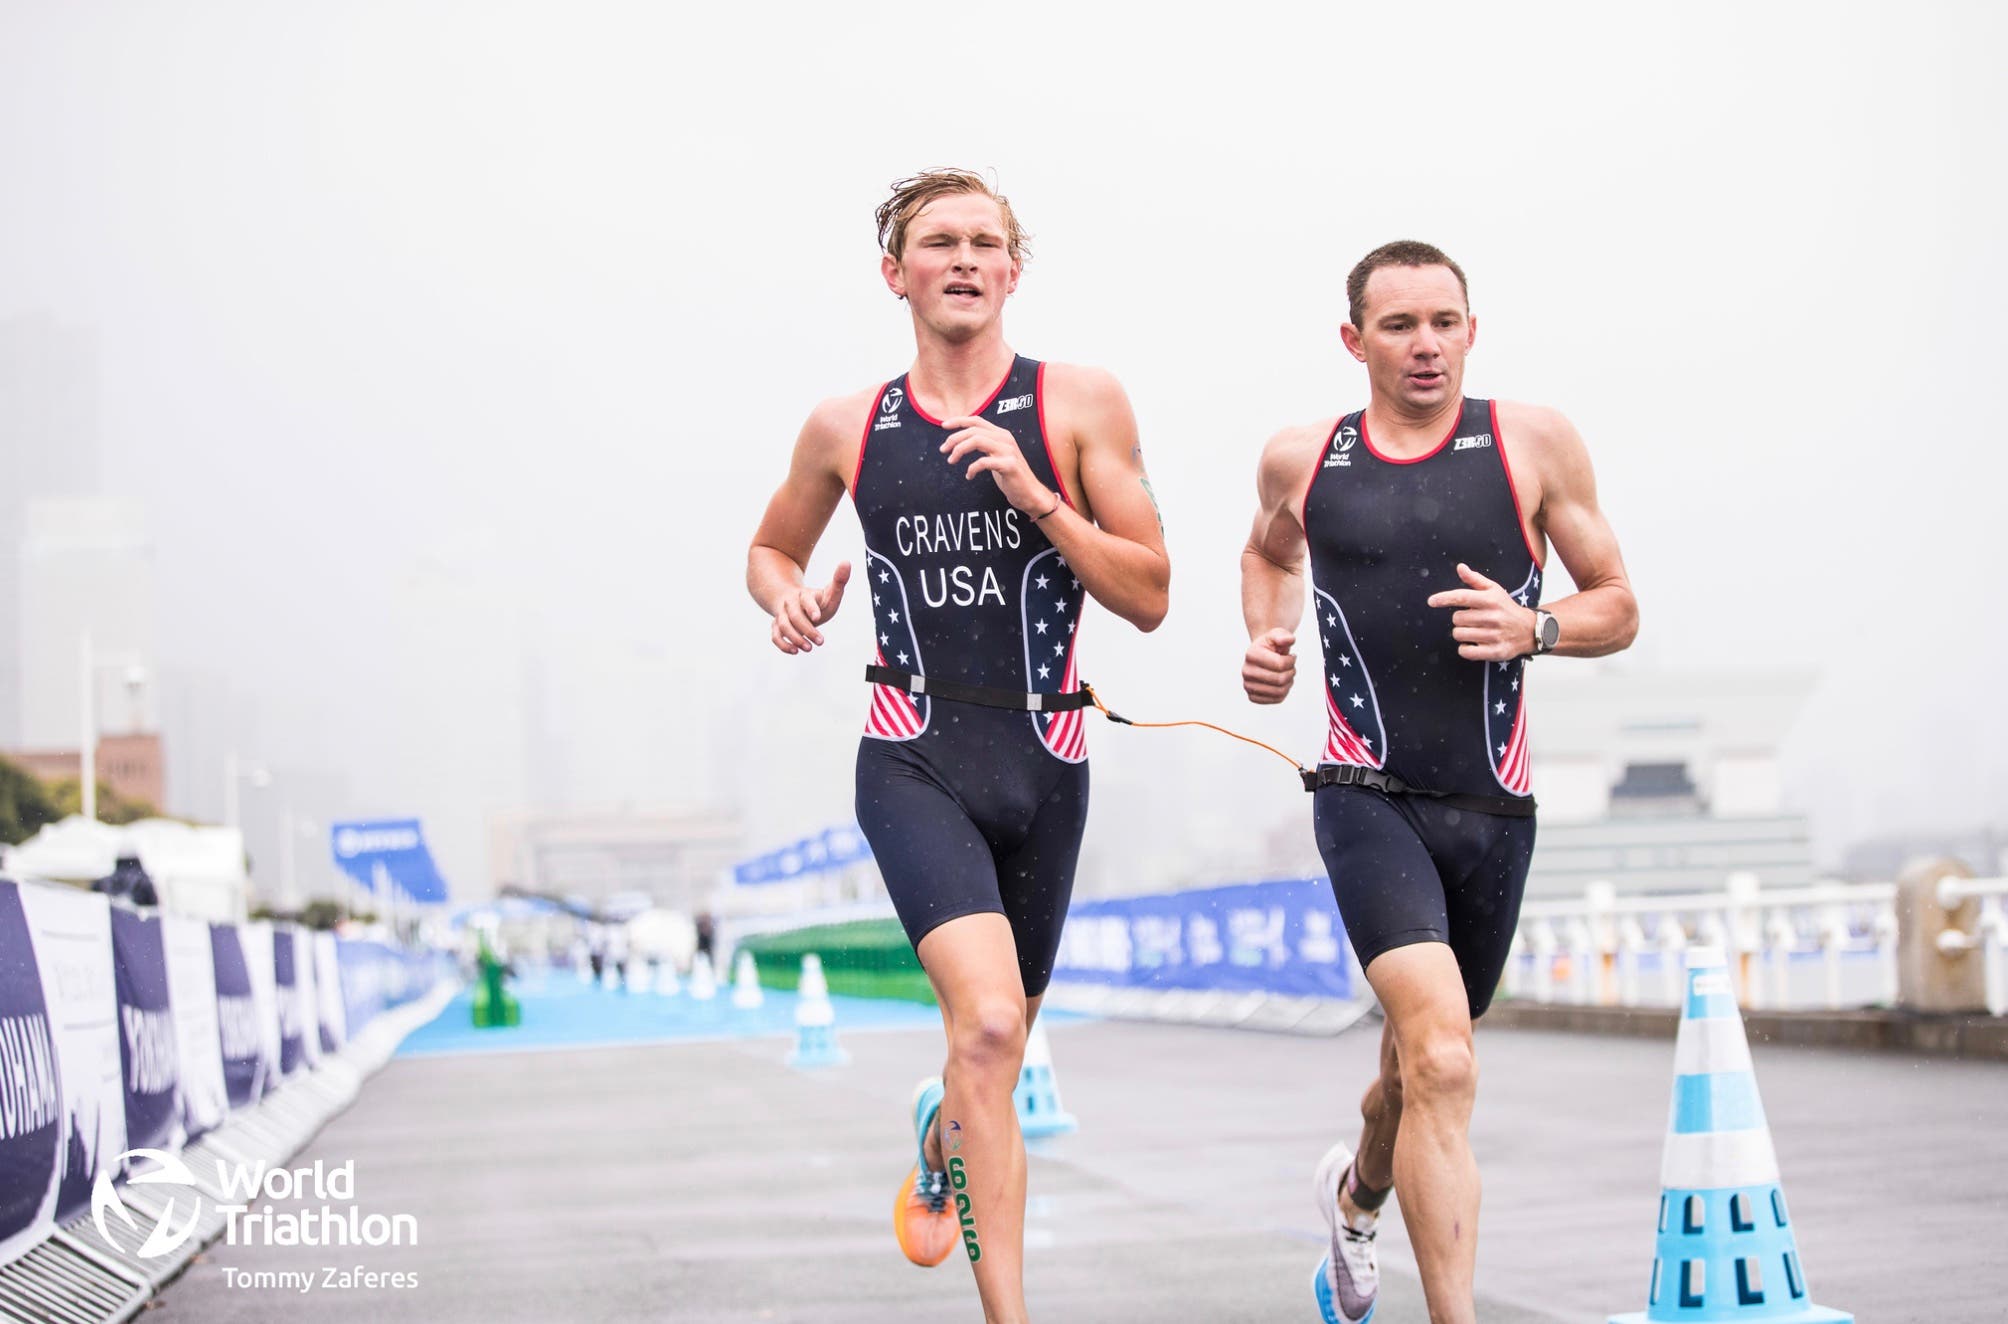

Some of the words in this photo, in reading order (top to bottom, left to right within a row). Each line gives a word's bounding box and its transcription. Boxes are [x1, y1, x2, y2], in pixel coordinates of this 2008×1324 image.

[1323, 460, 1352, 468] Triathlon
[1329, 452, 1350, 461] World
[896, 508, 1021, 557] CRAVENS
[919, 565, 1006, 608] USA
[948, 1156, 981, 1263] 626
